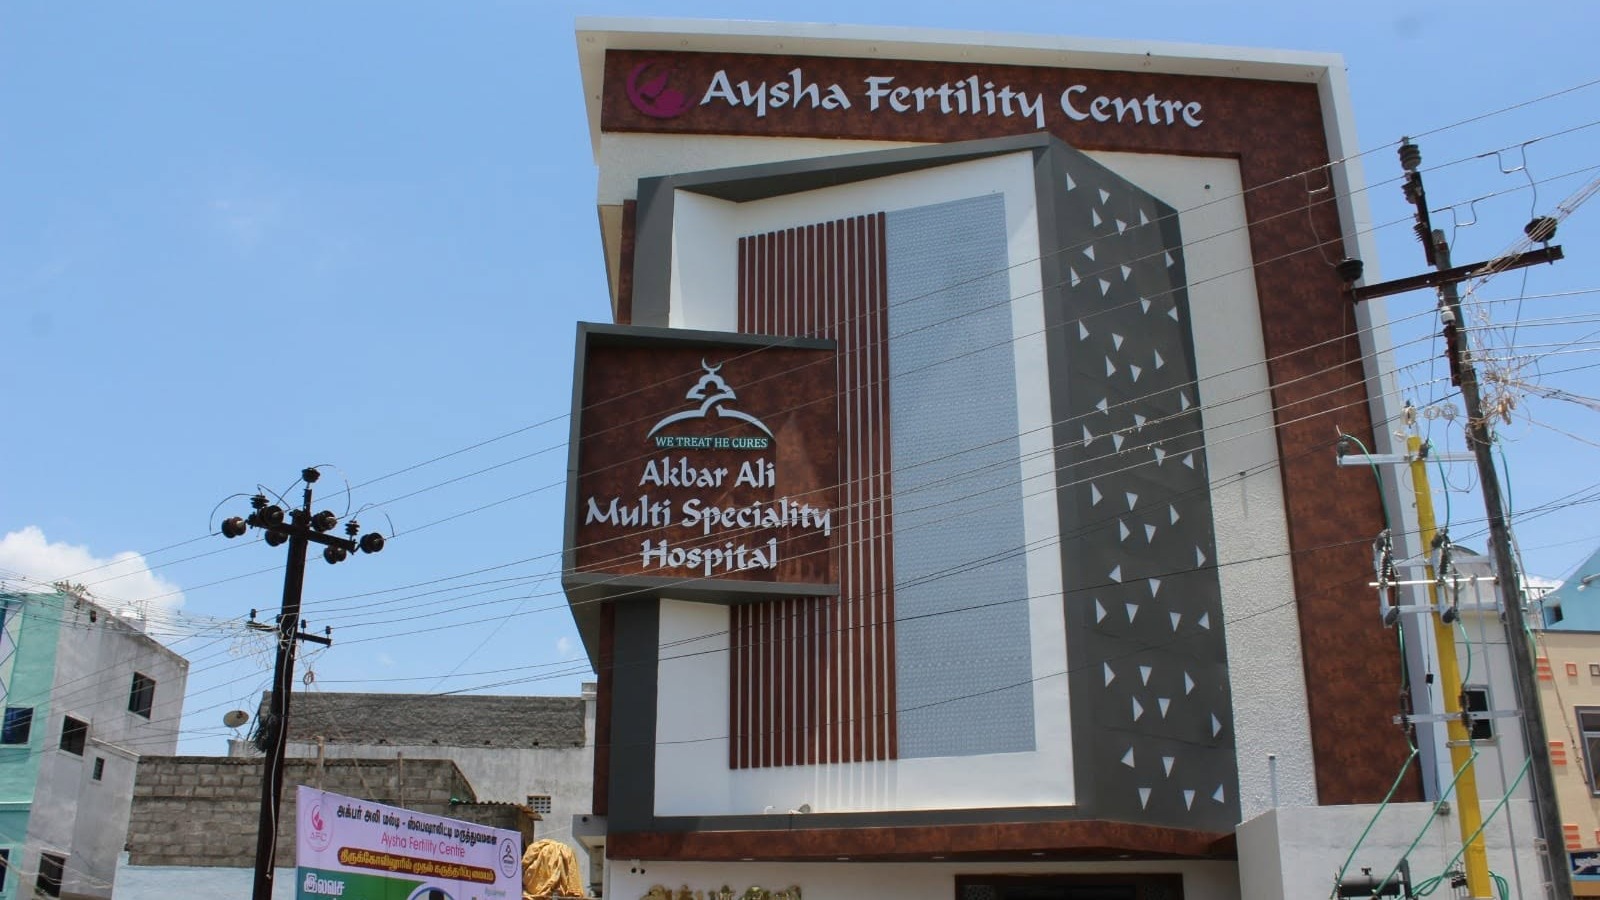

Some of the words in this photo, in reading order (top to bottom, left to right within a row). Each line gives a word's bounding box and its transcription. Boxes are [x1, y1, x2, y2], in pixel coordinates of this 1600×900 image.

[700, 69, 852, 118] Aysha
[864, 75, 1046, 129] Fertility
[1060, 84, 1204, 128] Centre
[655, 436, 674, 447] WE
[676, 436, 712, 448] TREAT
[714, 437, 730, 448] HE
[732, 437, 768, 449] CURES
[638, 456, 728, 487] Akbar
[734, 457, 776, 488] Ali
[585, 495, 671, 527] Multi
[681, 496, 831, 537] Speciality
[640, 537, 777, 577] Hospital
[336, 804, 363, 820] அக்பர்
[364, 809, 381, 824] அலி
[381, 832, 406, 848] Aysha
[409, 836, 437, 855] Fertility
[438, 841, 466, 858] Centre
[303, 873, 345, 896] இலவச
